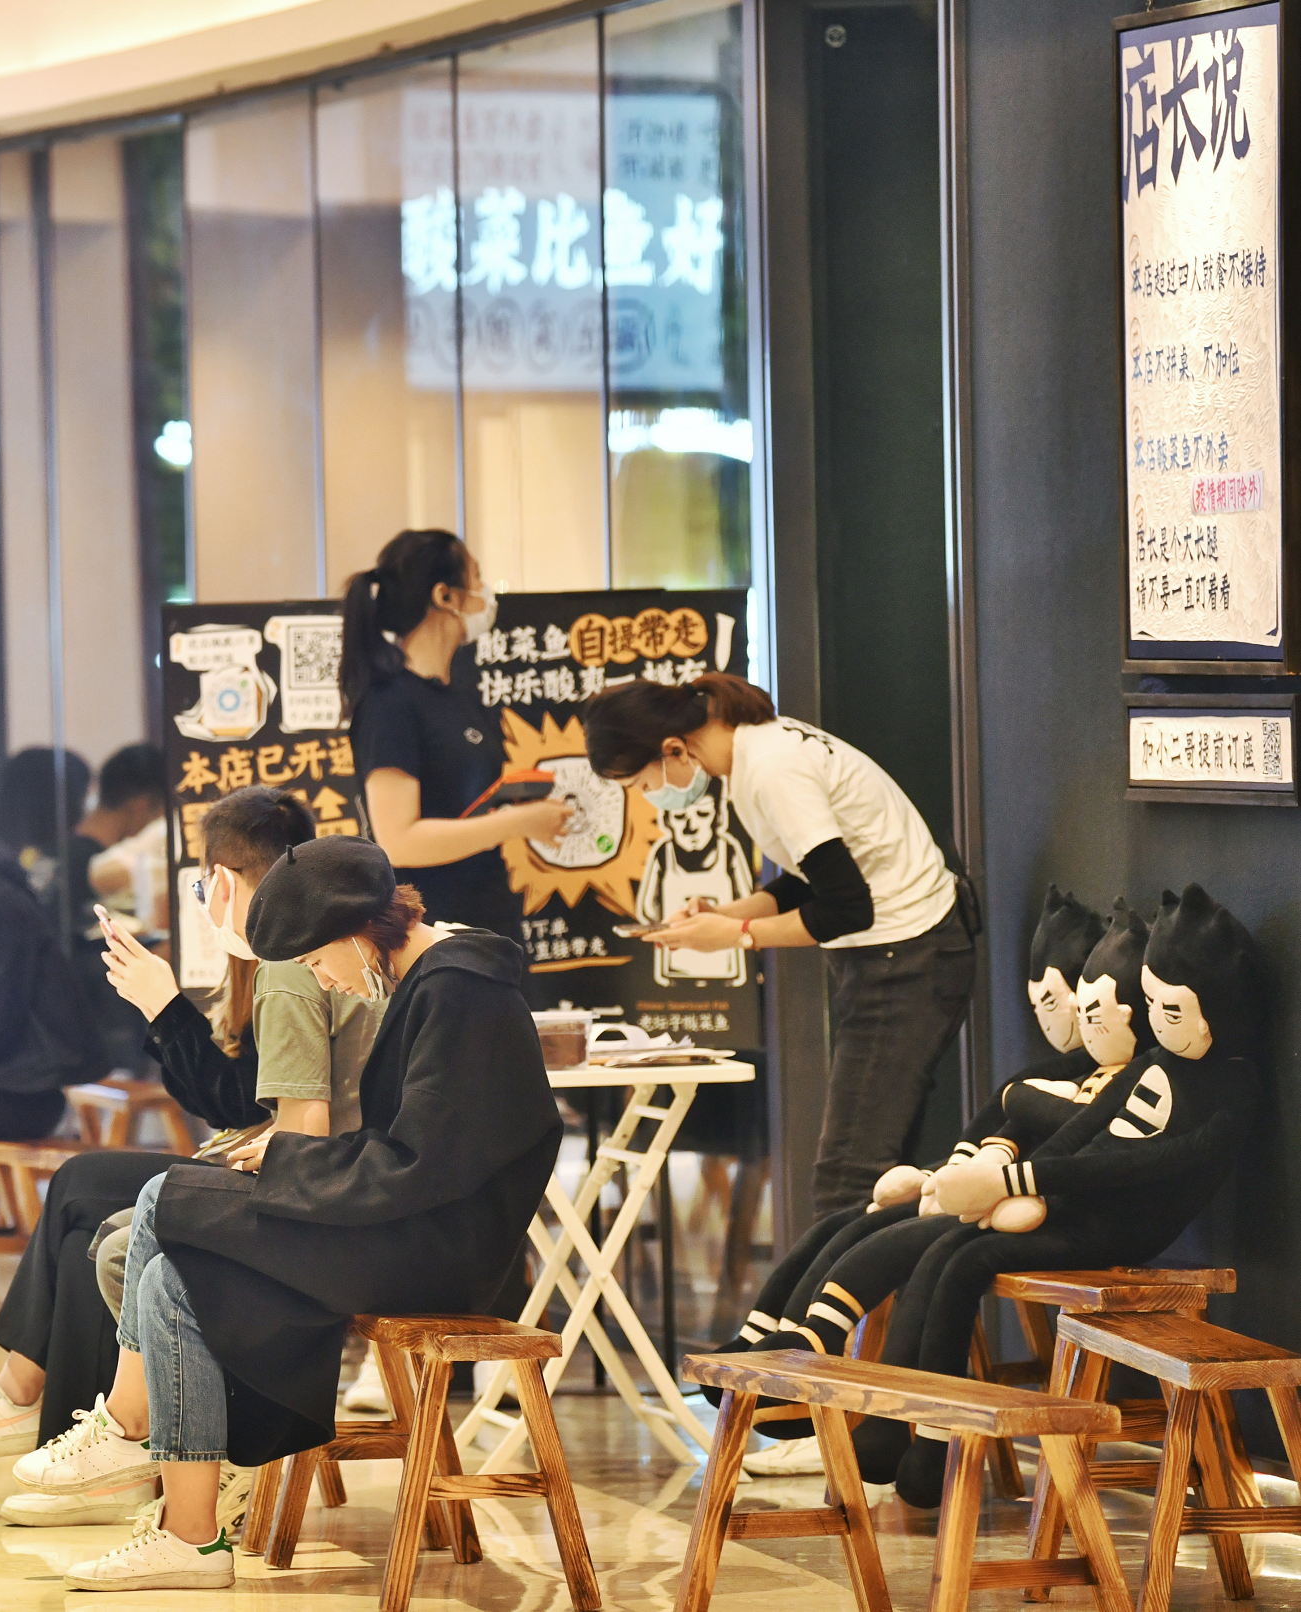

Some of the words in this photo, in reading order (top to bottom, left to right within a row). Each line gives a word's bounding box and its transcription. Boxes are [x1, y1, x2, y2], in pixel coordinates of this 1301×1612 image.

[1122, 28, 1251, 204] 店长说
[401, 186, 723, 295] 酸菜比鱼好
[1131, 246, 1267, 299] 本店超过四人就餐不接待
[1134, 431, 1229, 474] 本店酸菜鱼不外卖
[1135, 525, 1219, 563] 店长是个大长腿
[1136, 573, 1231, 611] 请不要一直盯着看
